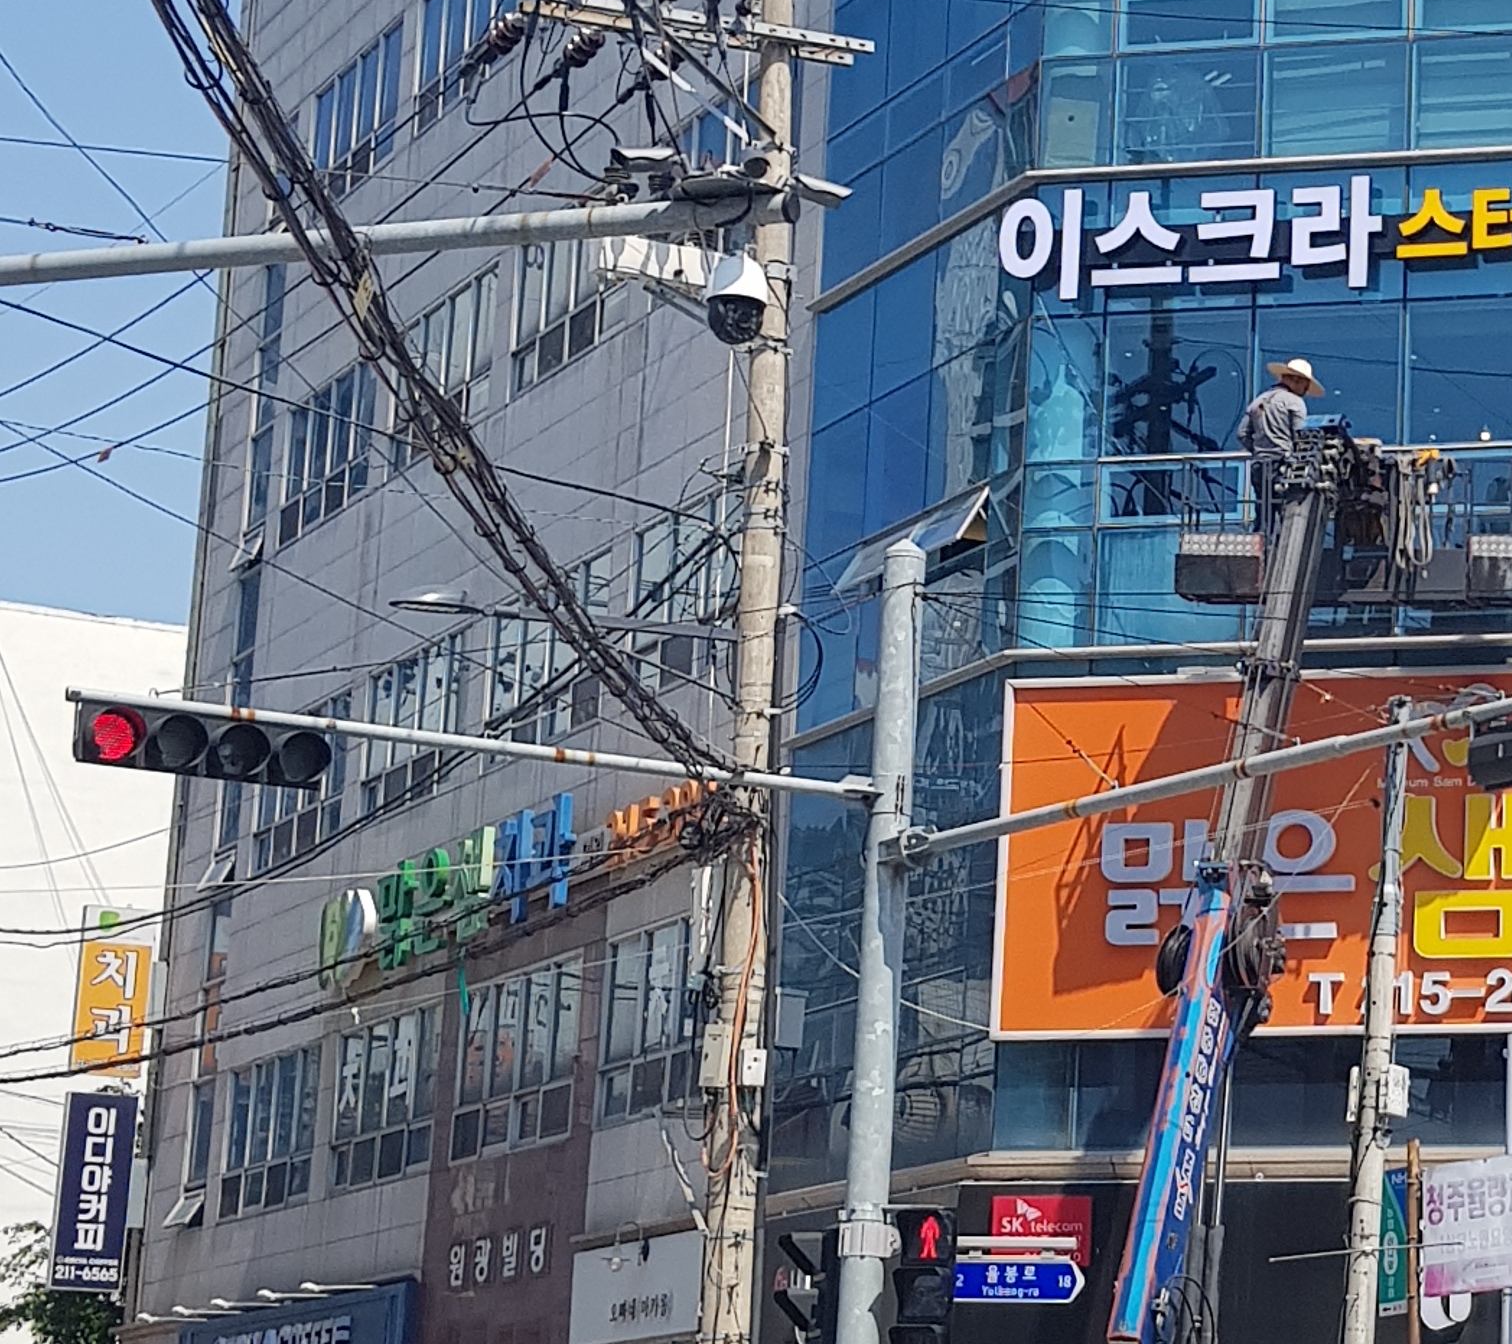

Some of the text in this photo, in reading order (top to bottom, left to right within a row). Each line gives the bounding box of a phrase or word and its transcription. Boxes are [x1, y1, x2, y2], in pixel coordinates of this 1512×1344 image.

[998, 174, 1383, 301] 이스크라
[90, 949, 138, 1055] 치과
[1308, 971, 1346, 1016] T
[74, 1106, 117, 1253] 이디야커피
[1000, 1217, 1024, 1233] SK
[54, 1264, 119, 1283] 211-6565
[448, 1224, 548, 1288] 원광빌딩
[1058, 1274, 1073, 1288] 18
